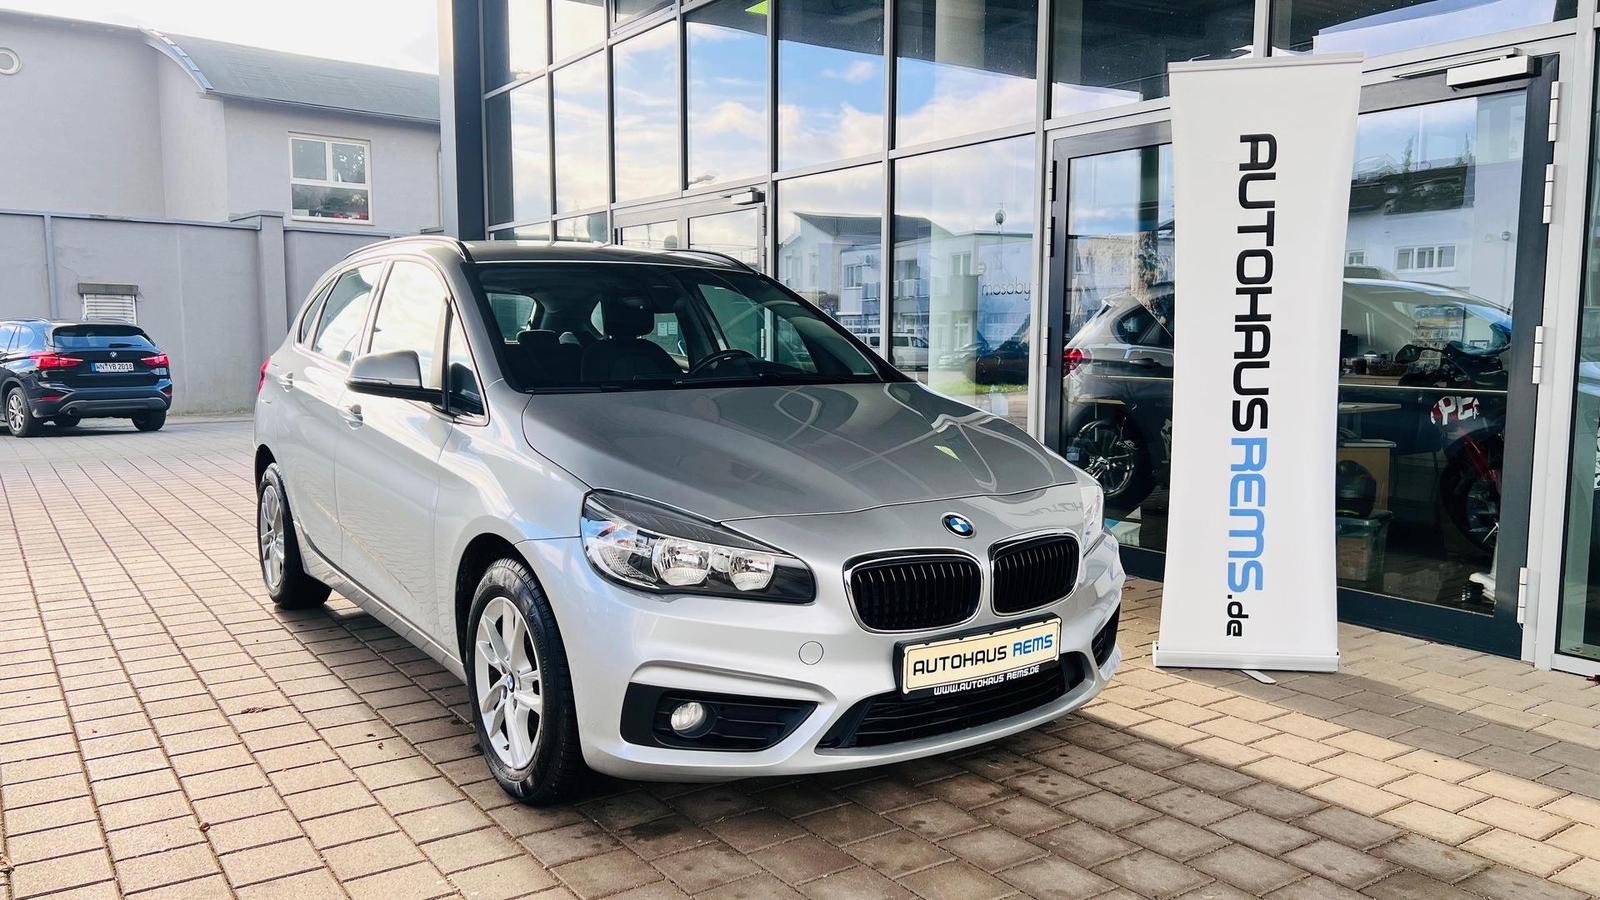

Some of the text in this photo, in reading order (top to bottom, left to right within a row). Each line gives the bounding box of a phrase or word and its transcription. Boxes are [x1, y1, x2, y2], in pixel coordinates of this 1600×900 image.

[913, 634, 1053, 676] AUTOHAUS REMS
[1007, 664, 1040, 680] REMS.DE
